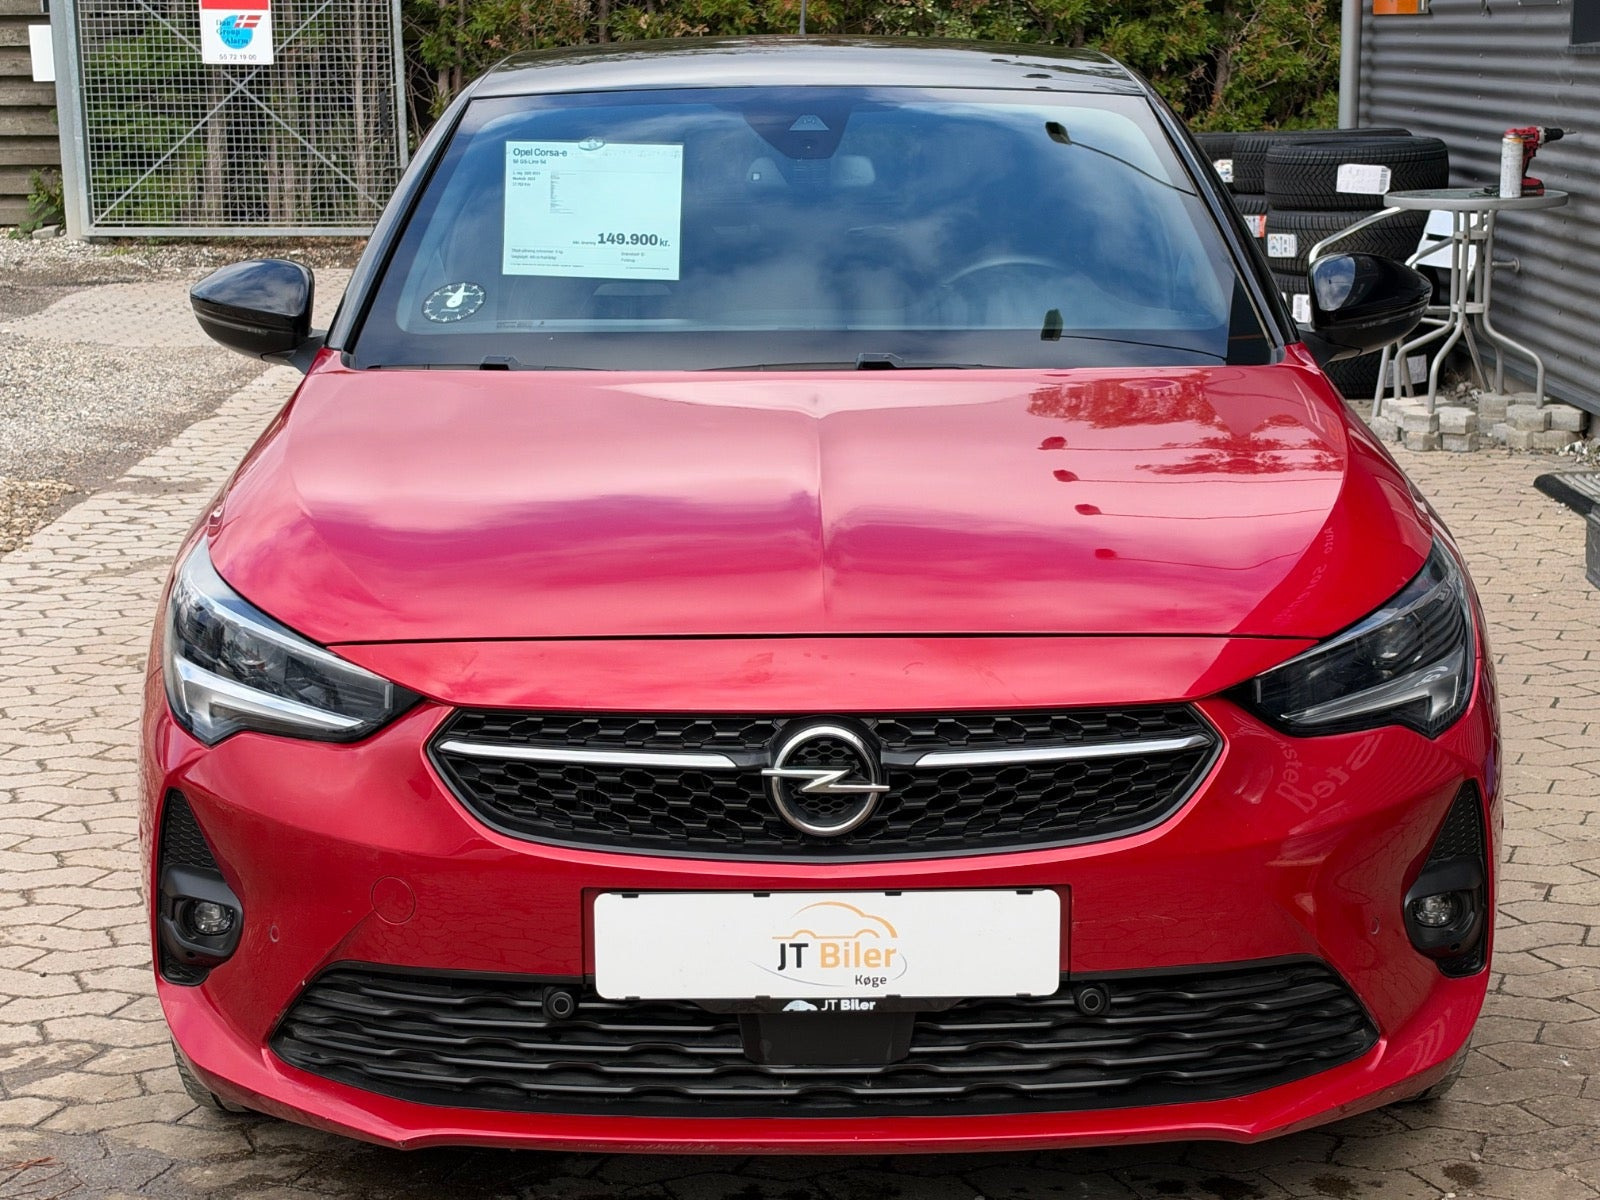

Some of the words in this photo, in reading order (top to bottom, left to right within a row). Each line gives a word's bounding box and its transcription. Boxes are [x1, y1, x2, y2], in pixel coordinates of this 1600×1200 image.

[216, 28, 241, 37] Group
[225, 37, 249, 45] Alarm
[513, 148, 533, 157] Opel
[534, 148, 568, 157] Corsa-e
[597, 232, 659, 246] 149.900
[659, 238, 671, 247] kr.
[777, 942, 809, 971] JT
[819, 942, 897, 969] Biler
[854, 973, 887, 988] Køge
[820, 1000, 840, 1012] JT
[840, 999, 876, 1012] Biler
